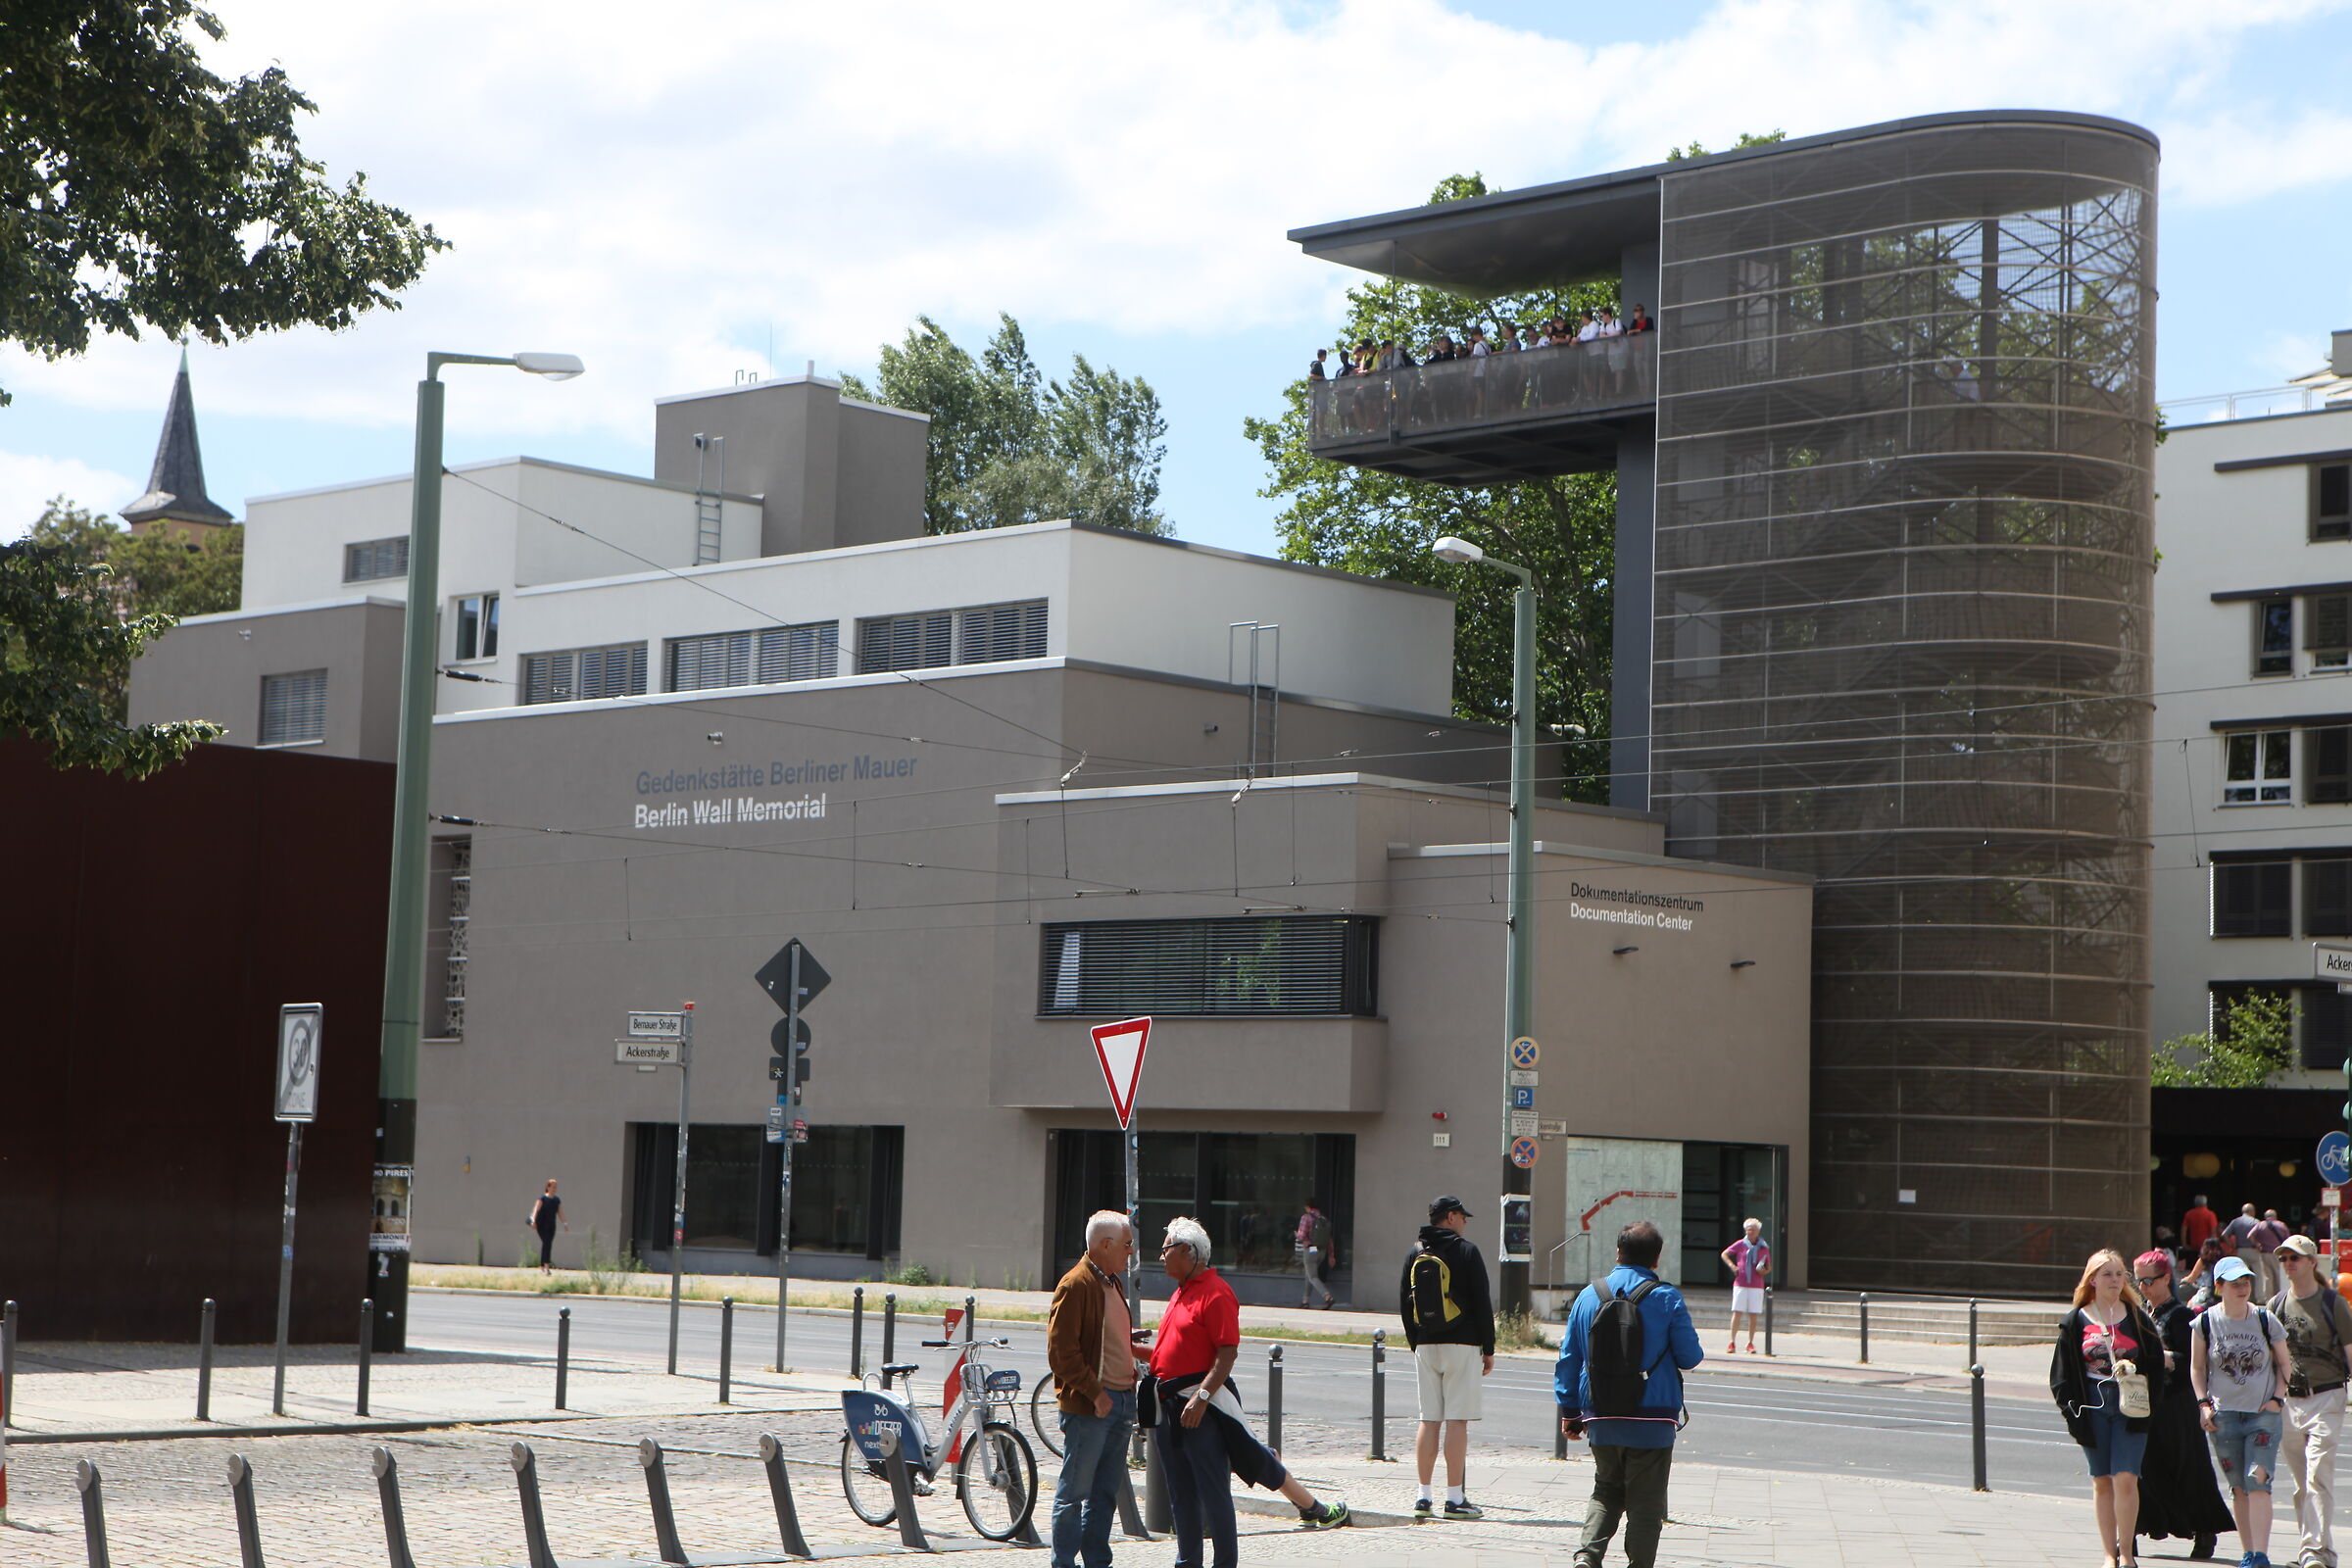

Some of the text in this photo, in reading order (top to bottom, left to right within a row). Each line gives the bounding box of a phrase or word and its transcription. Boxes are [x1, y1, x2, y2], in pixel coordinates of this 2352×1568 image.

[637, 754, 917, 795] Gedenkstätte Berliner Mauer
[635, 793, 826, 828] Berlin Wall Memorial
[1570, 882, 1704, 912] Dokumentationszentrum
[1570, 903, 1693, 931] Documentation Center
[633, 1018, 677, 1031] Bernauer Straße
[625, 1046, 670, 1059] Ackerstraße
[1517, 1090, 1528, 1105] P
